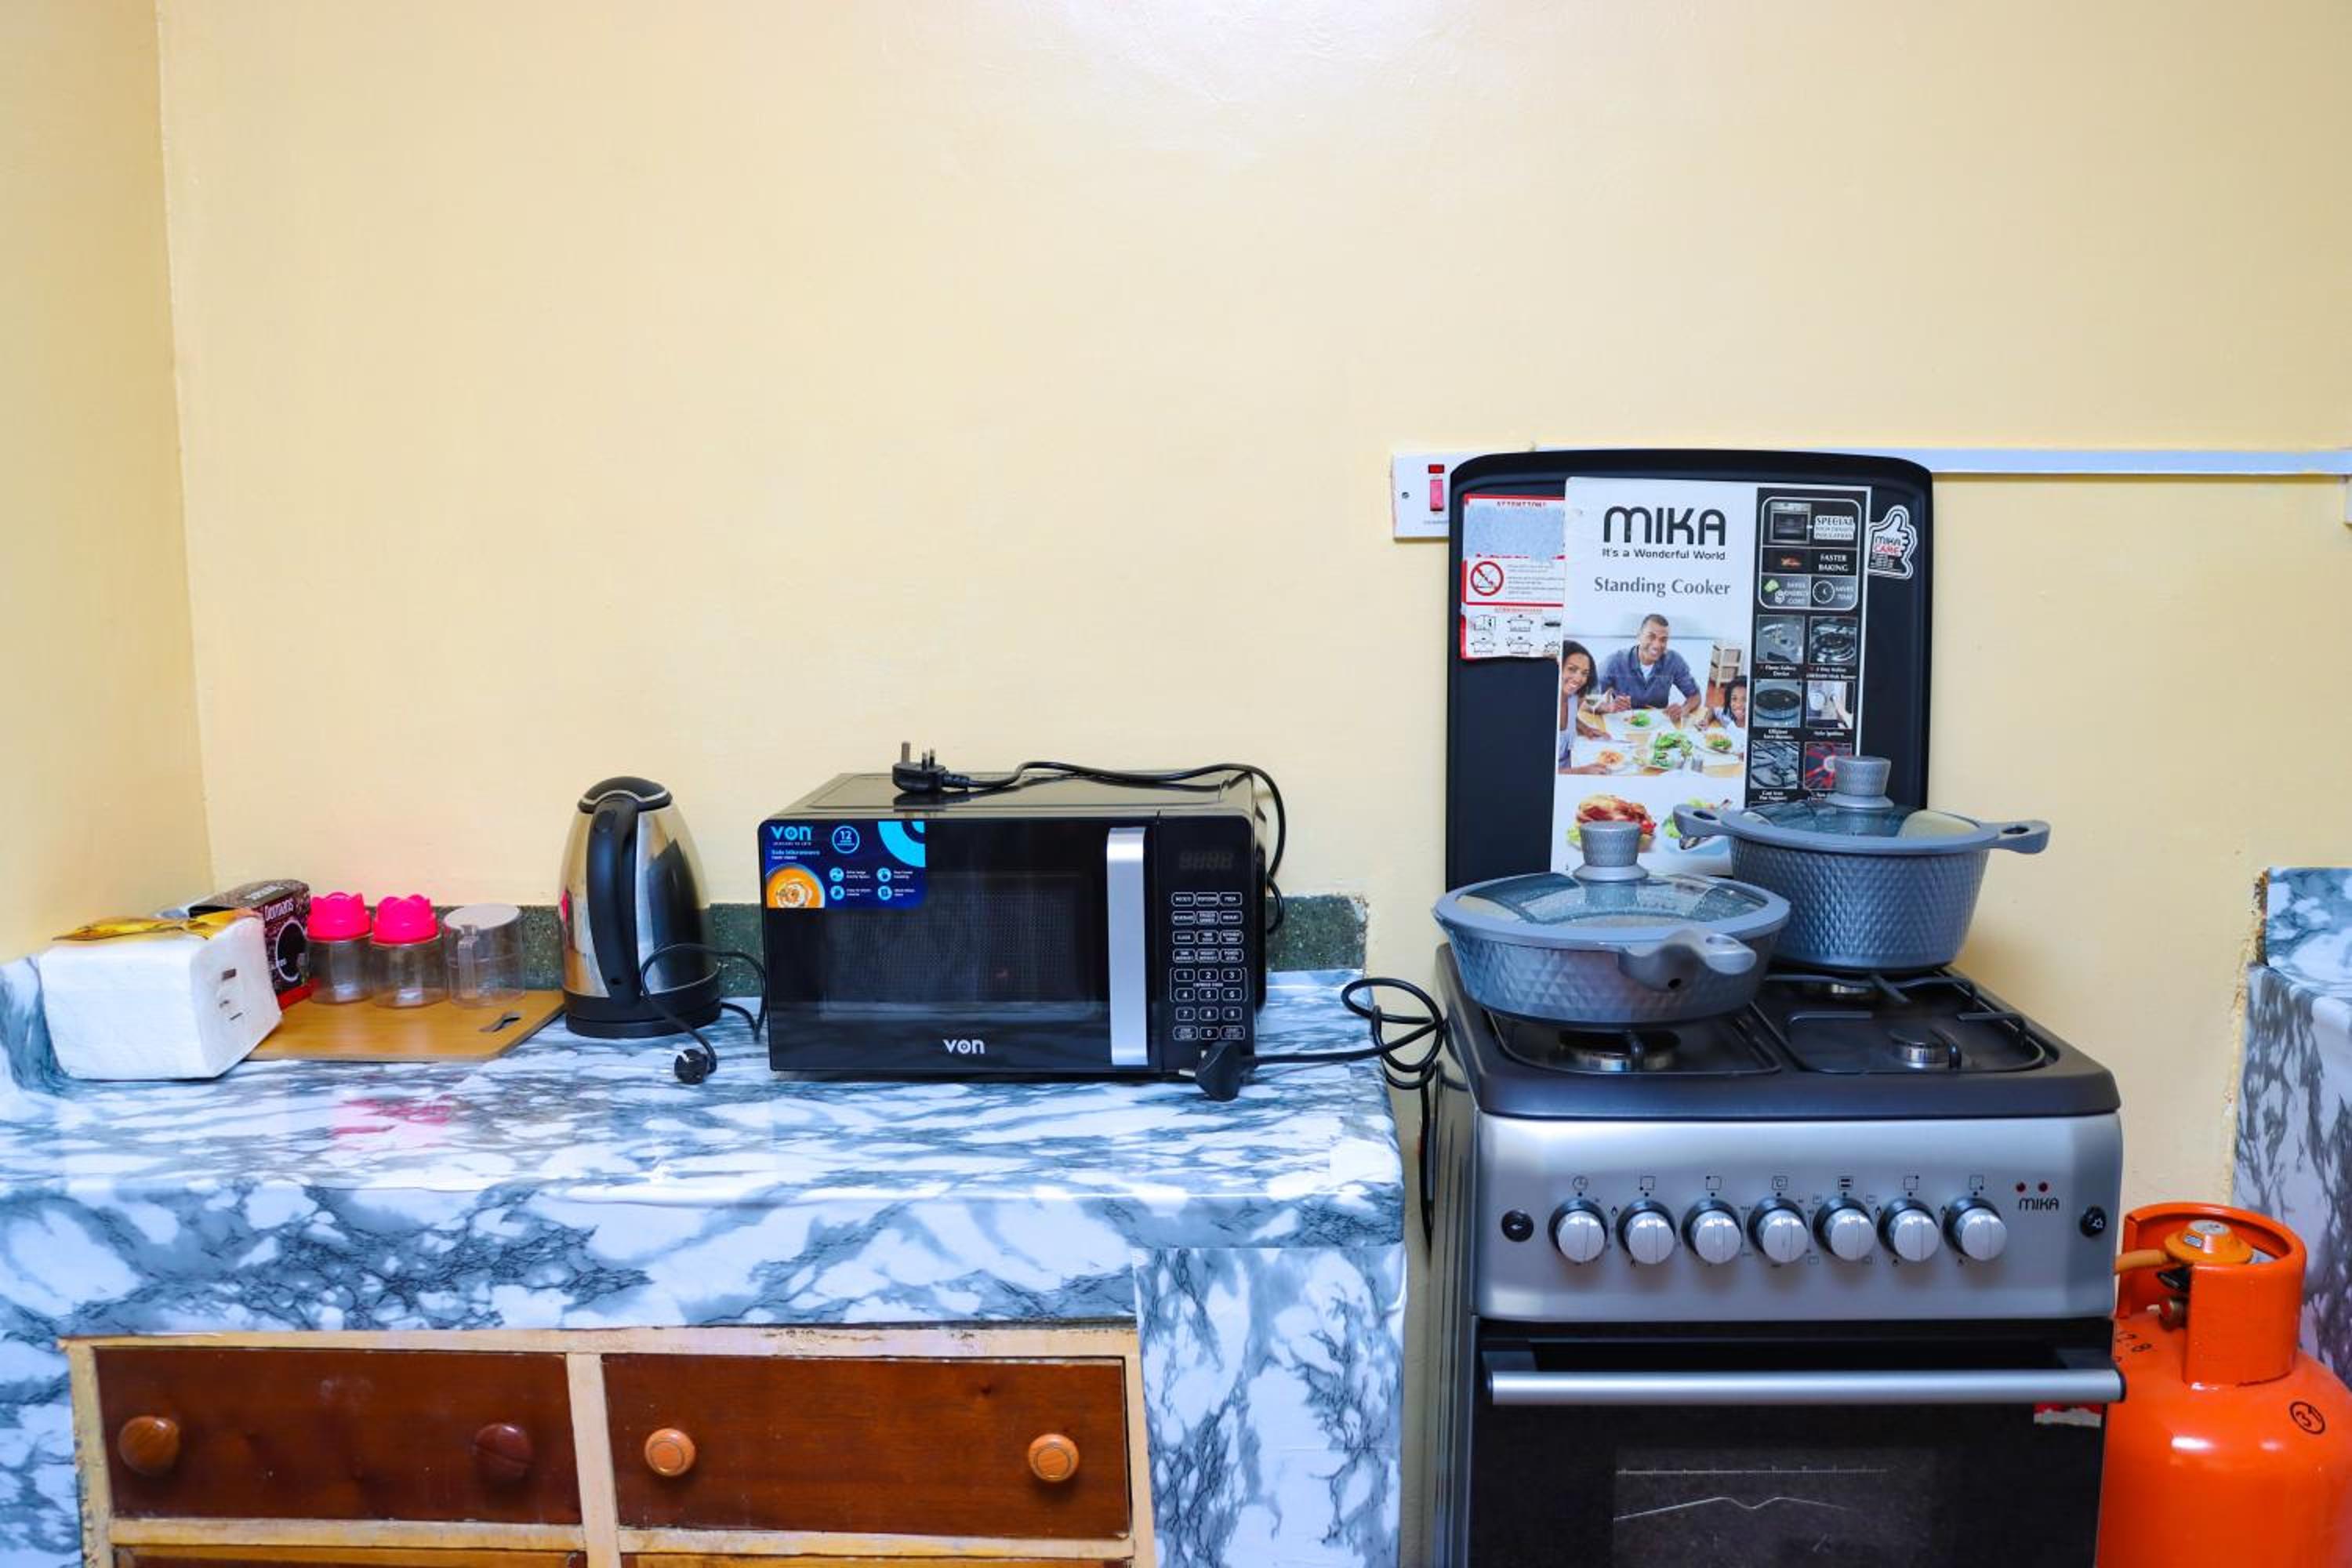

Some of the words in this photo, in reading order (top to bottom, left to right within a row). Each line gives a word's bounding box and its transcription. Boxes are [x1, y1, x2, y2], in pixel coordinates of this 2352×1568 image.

[1603, 506, 1726, 546] MIKA
[1816, 516, 1854, 525] SPECIAL
[1875, 535, 1901, 546] MIKA
[1602, 548, 1619, 557] It's
[1634, 549, 1690, 559] Wonderful
[1693, 550, 1726, 561] World
[1820, 554, 1848, 563] FASTER
[1818, 564, 1849, 572] BAKING
[1594, 576, 1666, 598] Standing
[1671, 579, 1730, 596] Cooker
[770, 826, 812, 841] von
[840, 830, 853, 840] 12
[942, 1039, 985, 1054] von
[2018, 1197, 2060, 1211] MIKA
